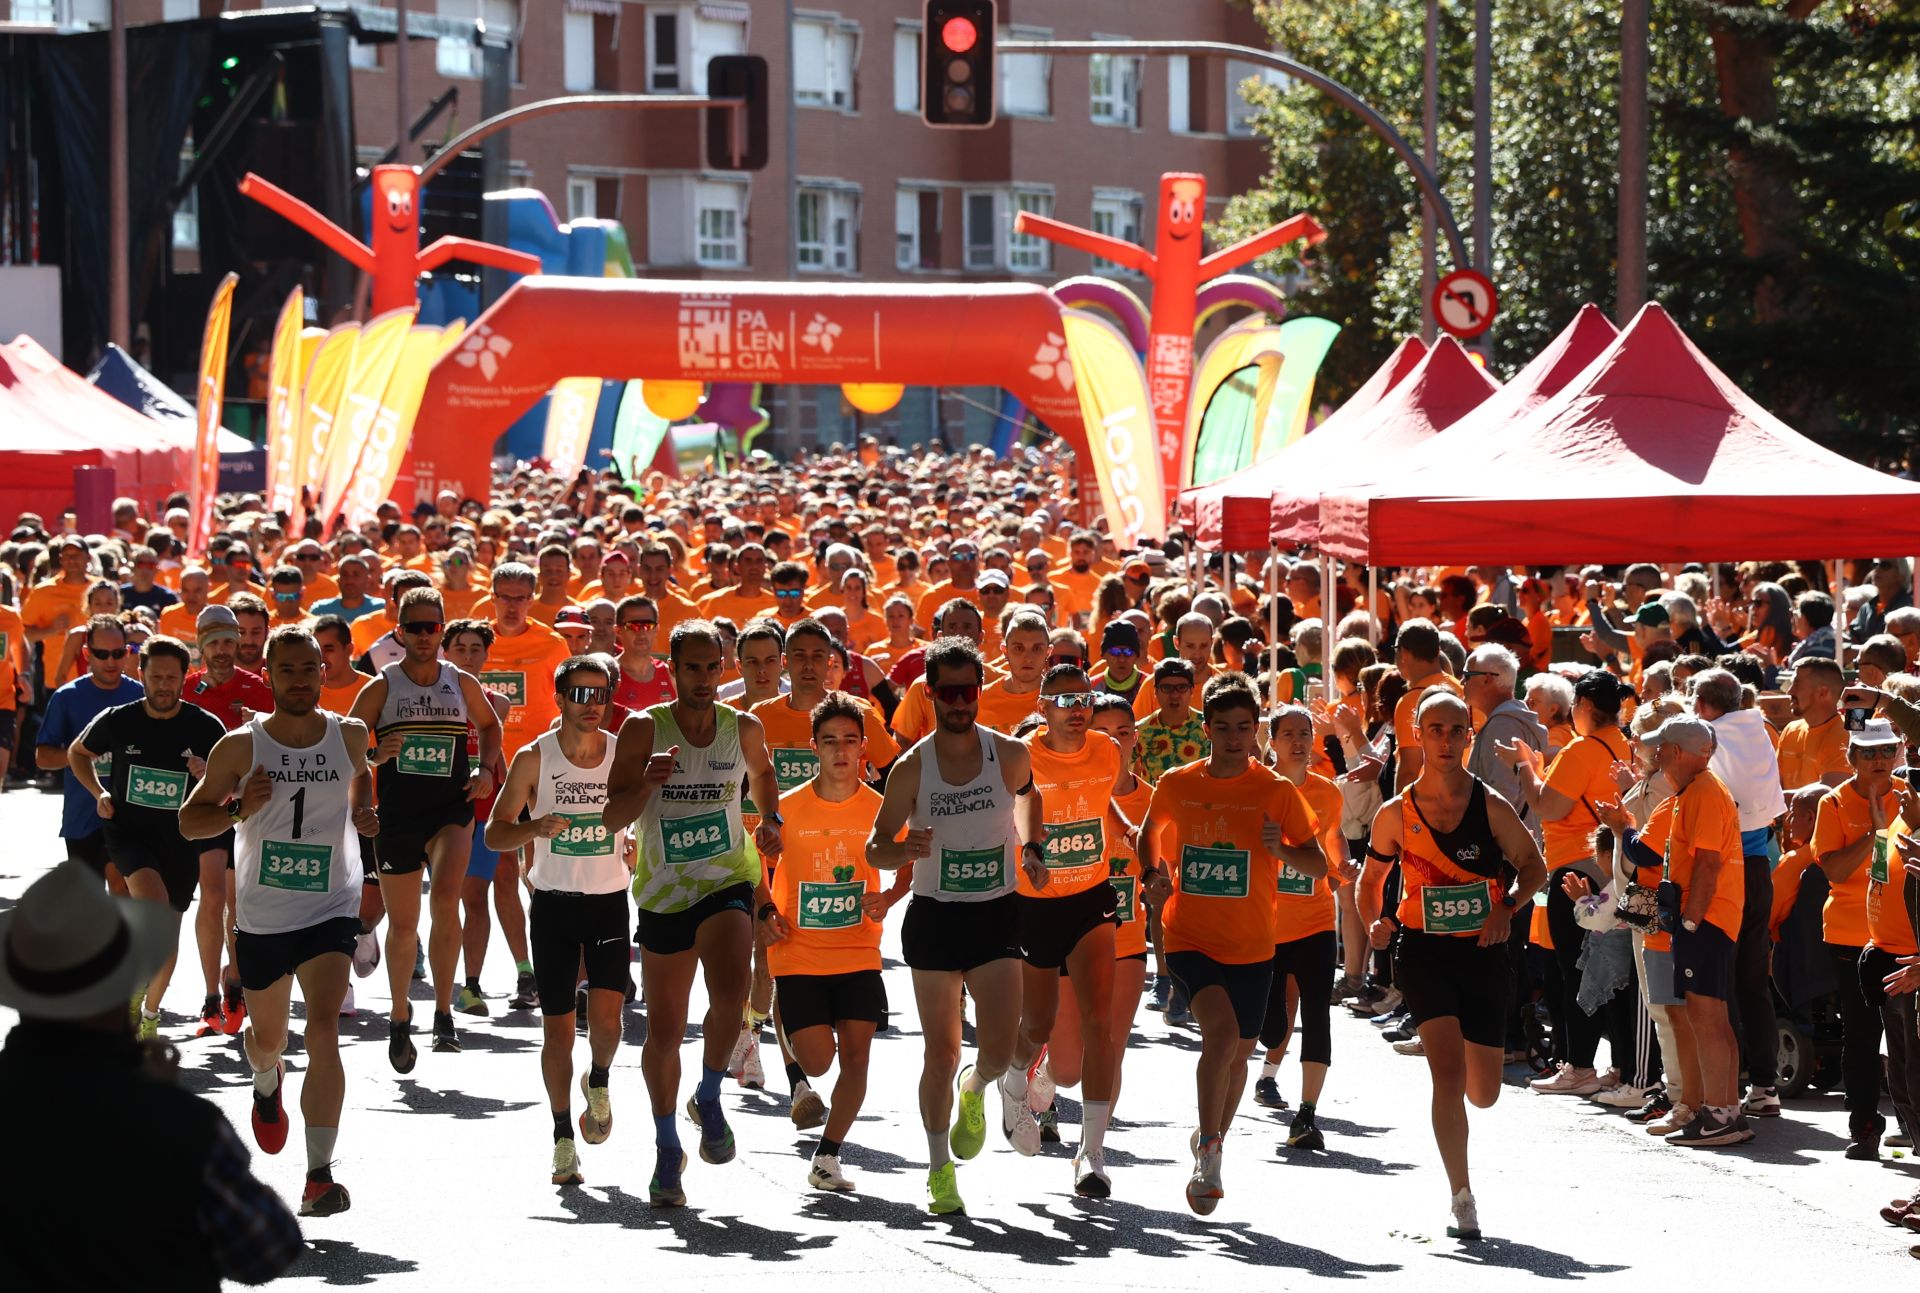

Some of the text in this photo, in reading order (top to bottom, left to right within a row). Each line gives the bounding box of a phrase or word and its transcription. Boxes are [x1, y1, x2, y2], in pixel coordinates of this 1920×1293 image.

[737, 310, 769, 329] PA
[737, 331, 785, 352] LEN
[737, 353, 780, 369] CIA
[281, 754, 326, 769] E y D
[405, 746, 447, 762] 4124
[267, 769, 340, 783] PALENCIA
[134, 778, 178, 797] 3420
[555, 781, 607, 794] CORRIEND
[930, 785, 993, 802] CORRIENDO
[289, 786, 306, 840] 1
[930, 799, 996, 816] PALENCIA
[558, 825, 607, 843] 3849
[669, 825, 722, 849] 4842
[1046, 833, 1097, 854] 4862
[268, 855, 321, 877] 3243
[947, 860, 999, 879] 5529
[1186, 861, 1238, 881] 4744
[1053, 876, 1062, 884] EL
[807, 895, 856, 914] 4750
[1432, 898, 1483, 918] 3593
